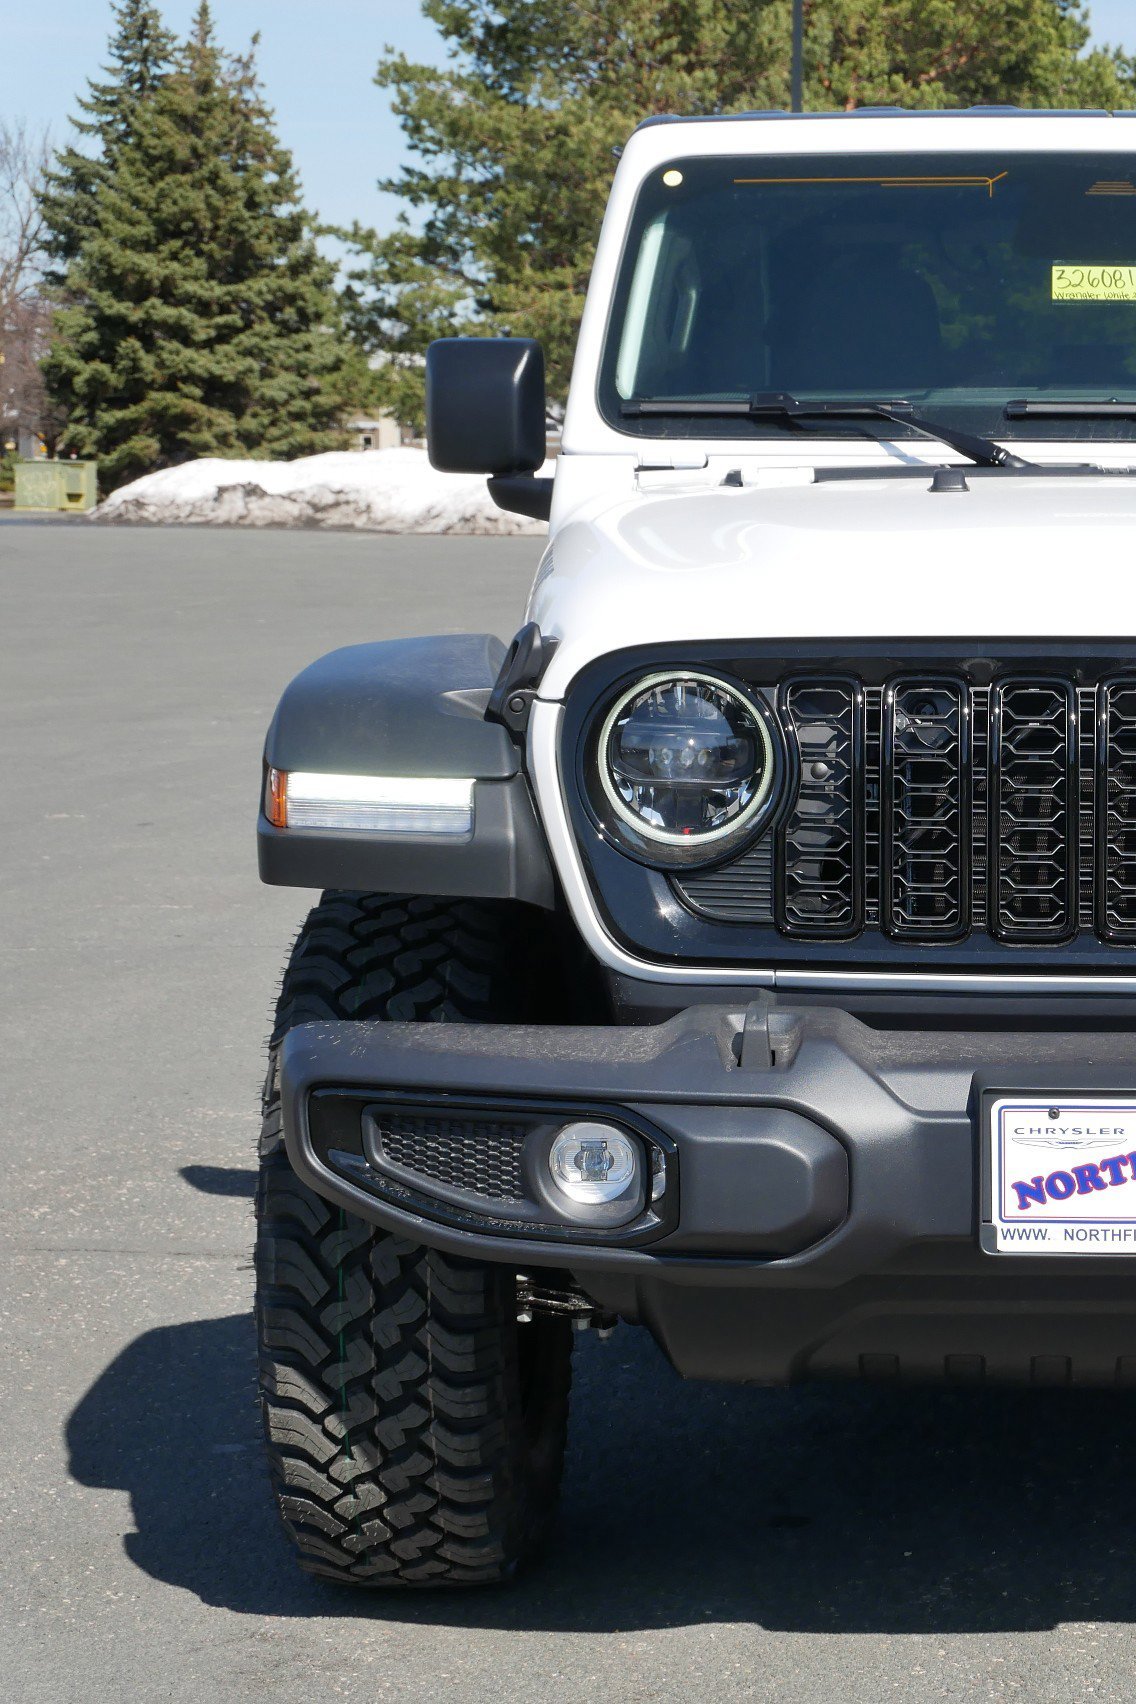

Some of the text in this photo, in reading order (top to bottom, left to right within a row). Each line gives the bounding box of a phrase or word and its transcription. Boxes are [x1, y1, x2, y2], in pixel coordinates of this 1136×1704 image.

[1055, 269, 1134, 289] 326081
[1054, 291, 1101, 300] Wrangler
[1103, 291, 1129, 300] White
[1013, 1127, 1125, 1135] CHRYSLER
